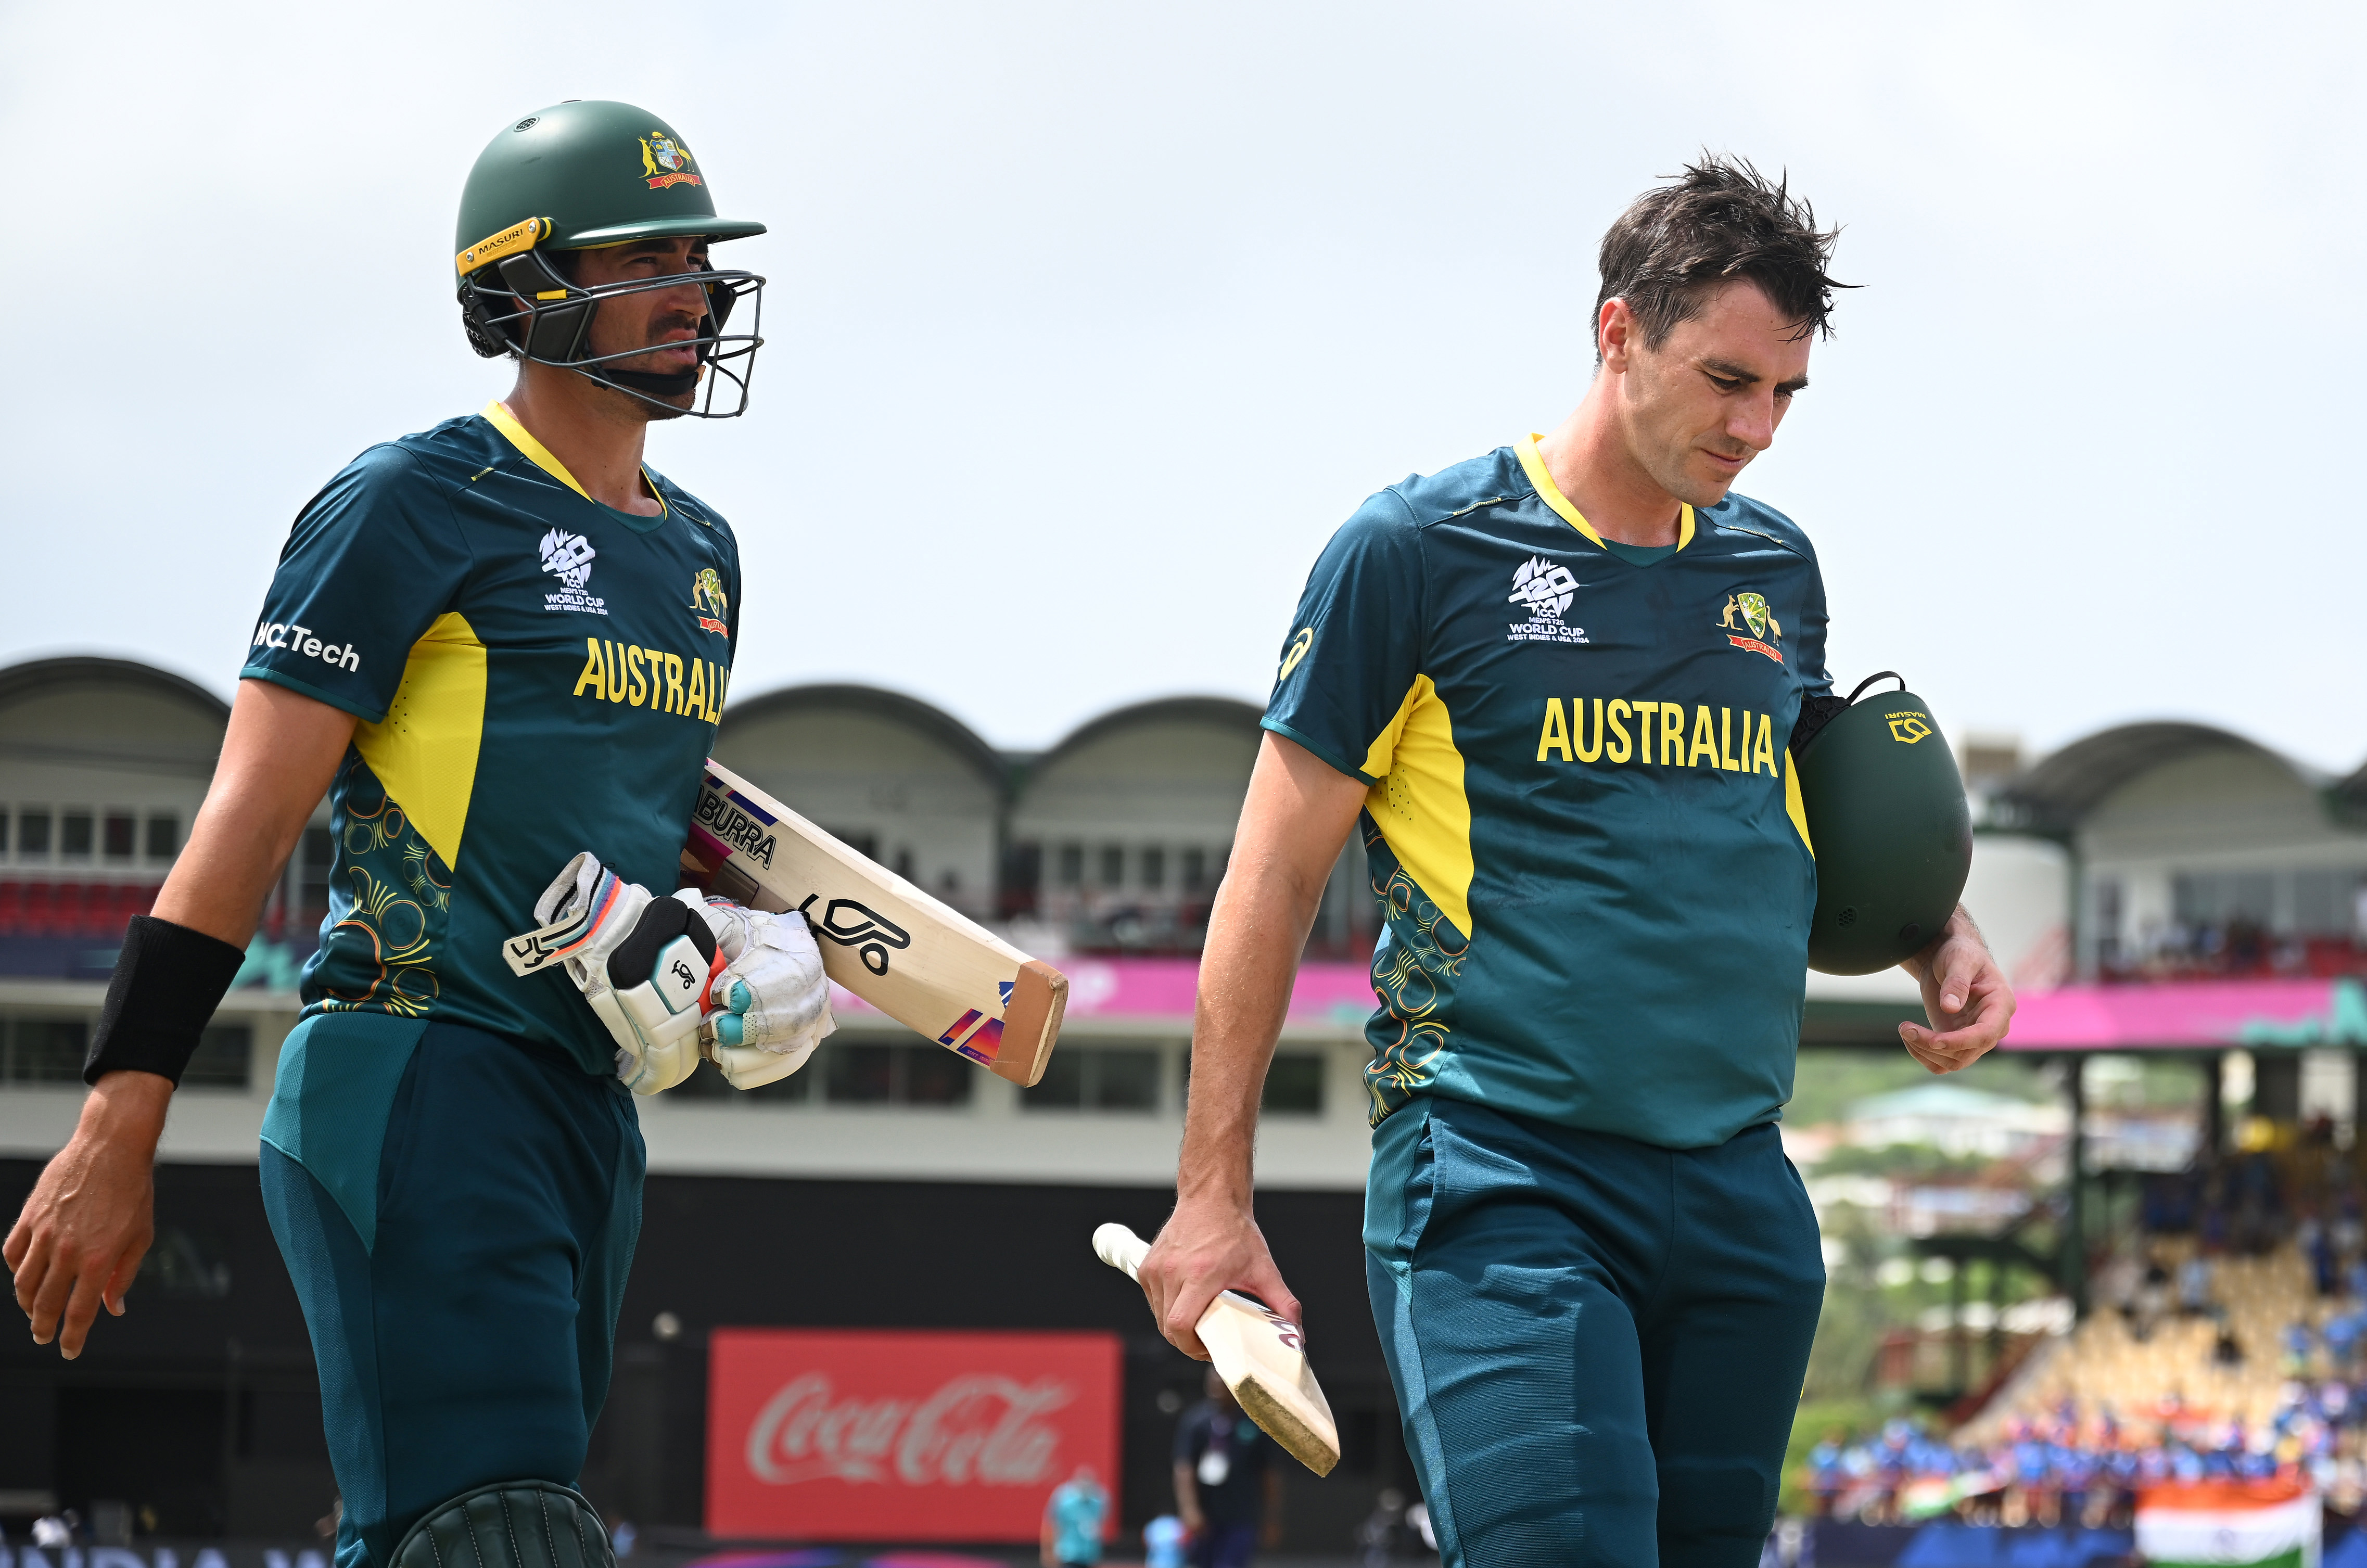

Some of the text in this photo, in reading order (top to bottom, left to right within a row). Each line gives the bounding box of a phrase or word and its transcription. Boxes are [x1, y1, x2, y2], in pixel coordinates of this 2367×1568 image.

[664, 174, 694, 186] AUSTRALIA
[478, 228, 524, 254] MASURI
[566, 578, 580, 589] ICC
[560, 587, 578, 595] MEN'S
[545, 594, 604, 607] WORLD CUP
[1536, 608, 1556, 618] ICC
[1509, 623, 1584, 637] WORLD CUP
[253, 621, 360, 672] HCLTech
[1744, 641, 1776, 658] AUSTRALIA
[573, 638, 728, 726] AUSTRALI
[1885, 711, 1926, 720] MASURI
[1536, 698, 1778, 778] AUSTRALIA
